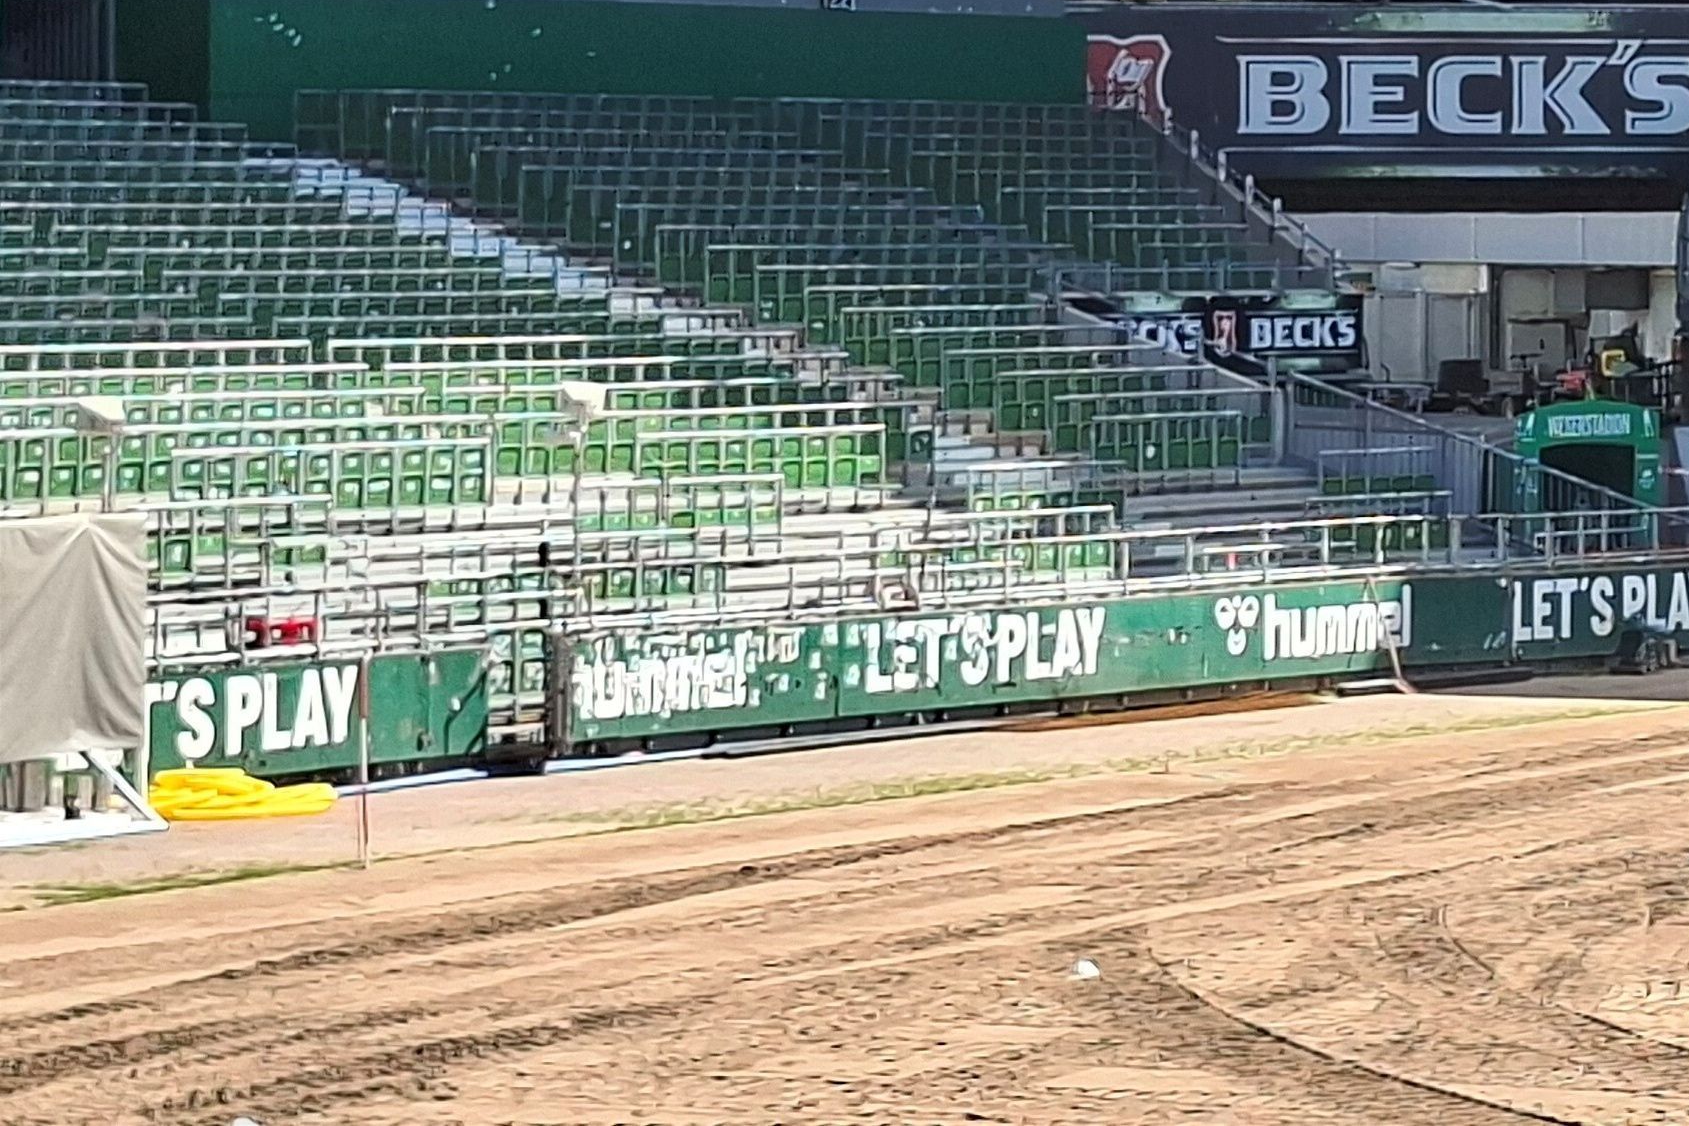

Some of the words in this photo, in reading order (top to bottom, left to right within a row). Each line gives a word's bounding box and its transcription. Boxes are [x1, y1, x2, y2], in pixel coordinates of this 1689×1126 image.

[1264, 583, 1413, 661] hummel
[1513, 576, 1616, 641] LET'S
[864, 612, 991, 694] LET'S
[997, 607, 1106, 682] PLAY
[225, 665, 359, 756] PLAY
